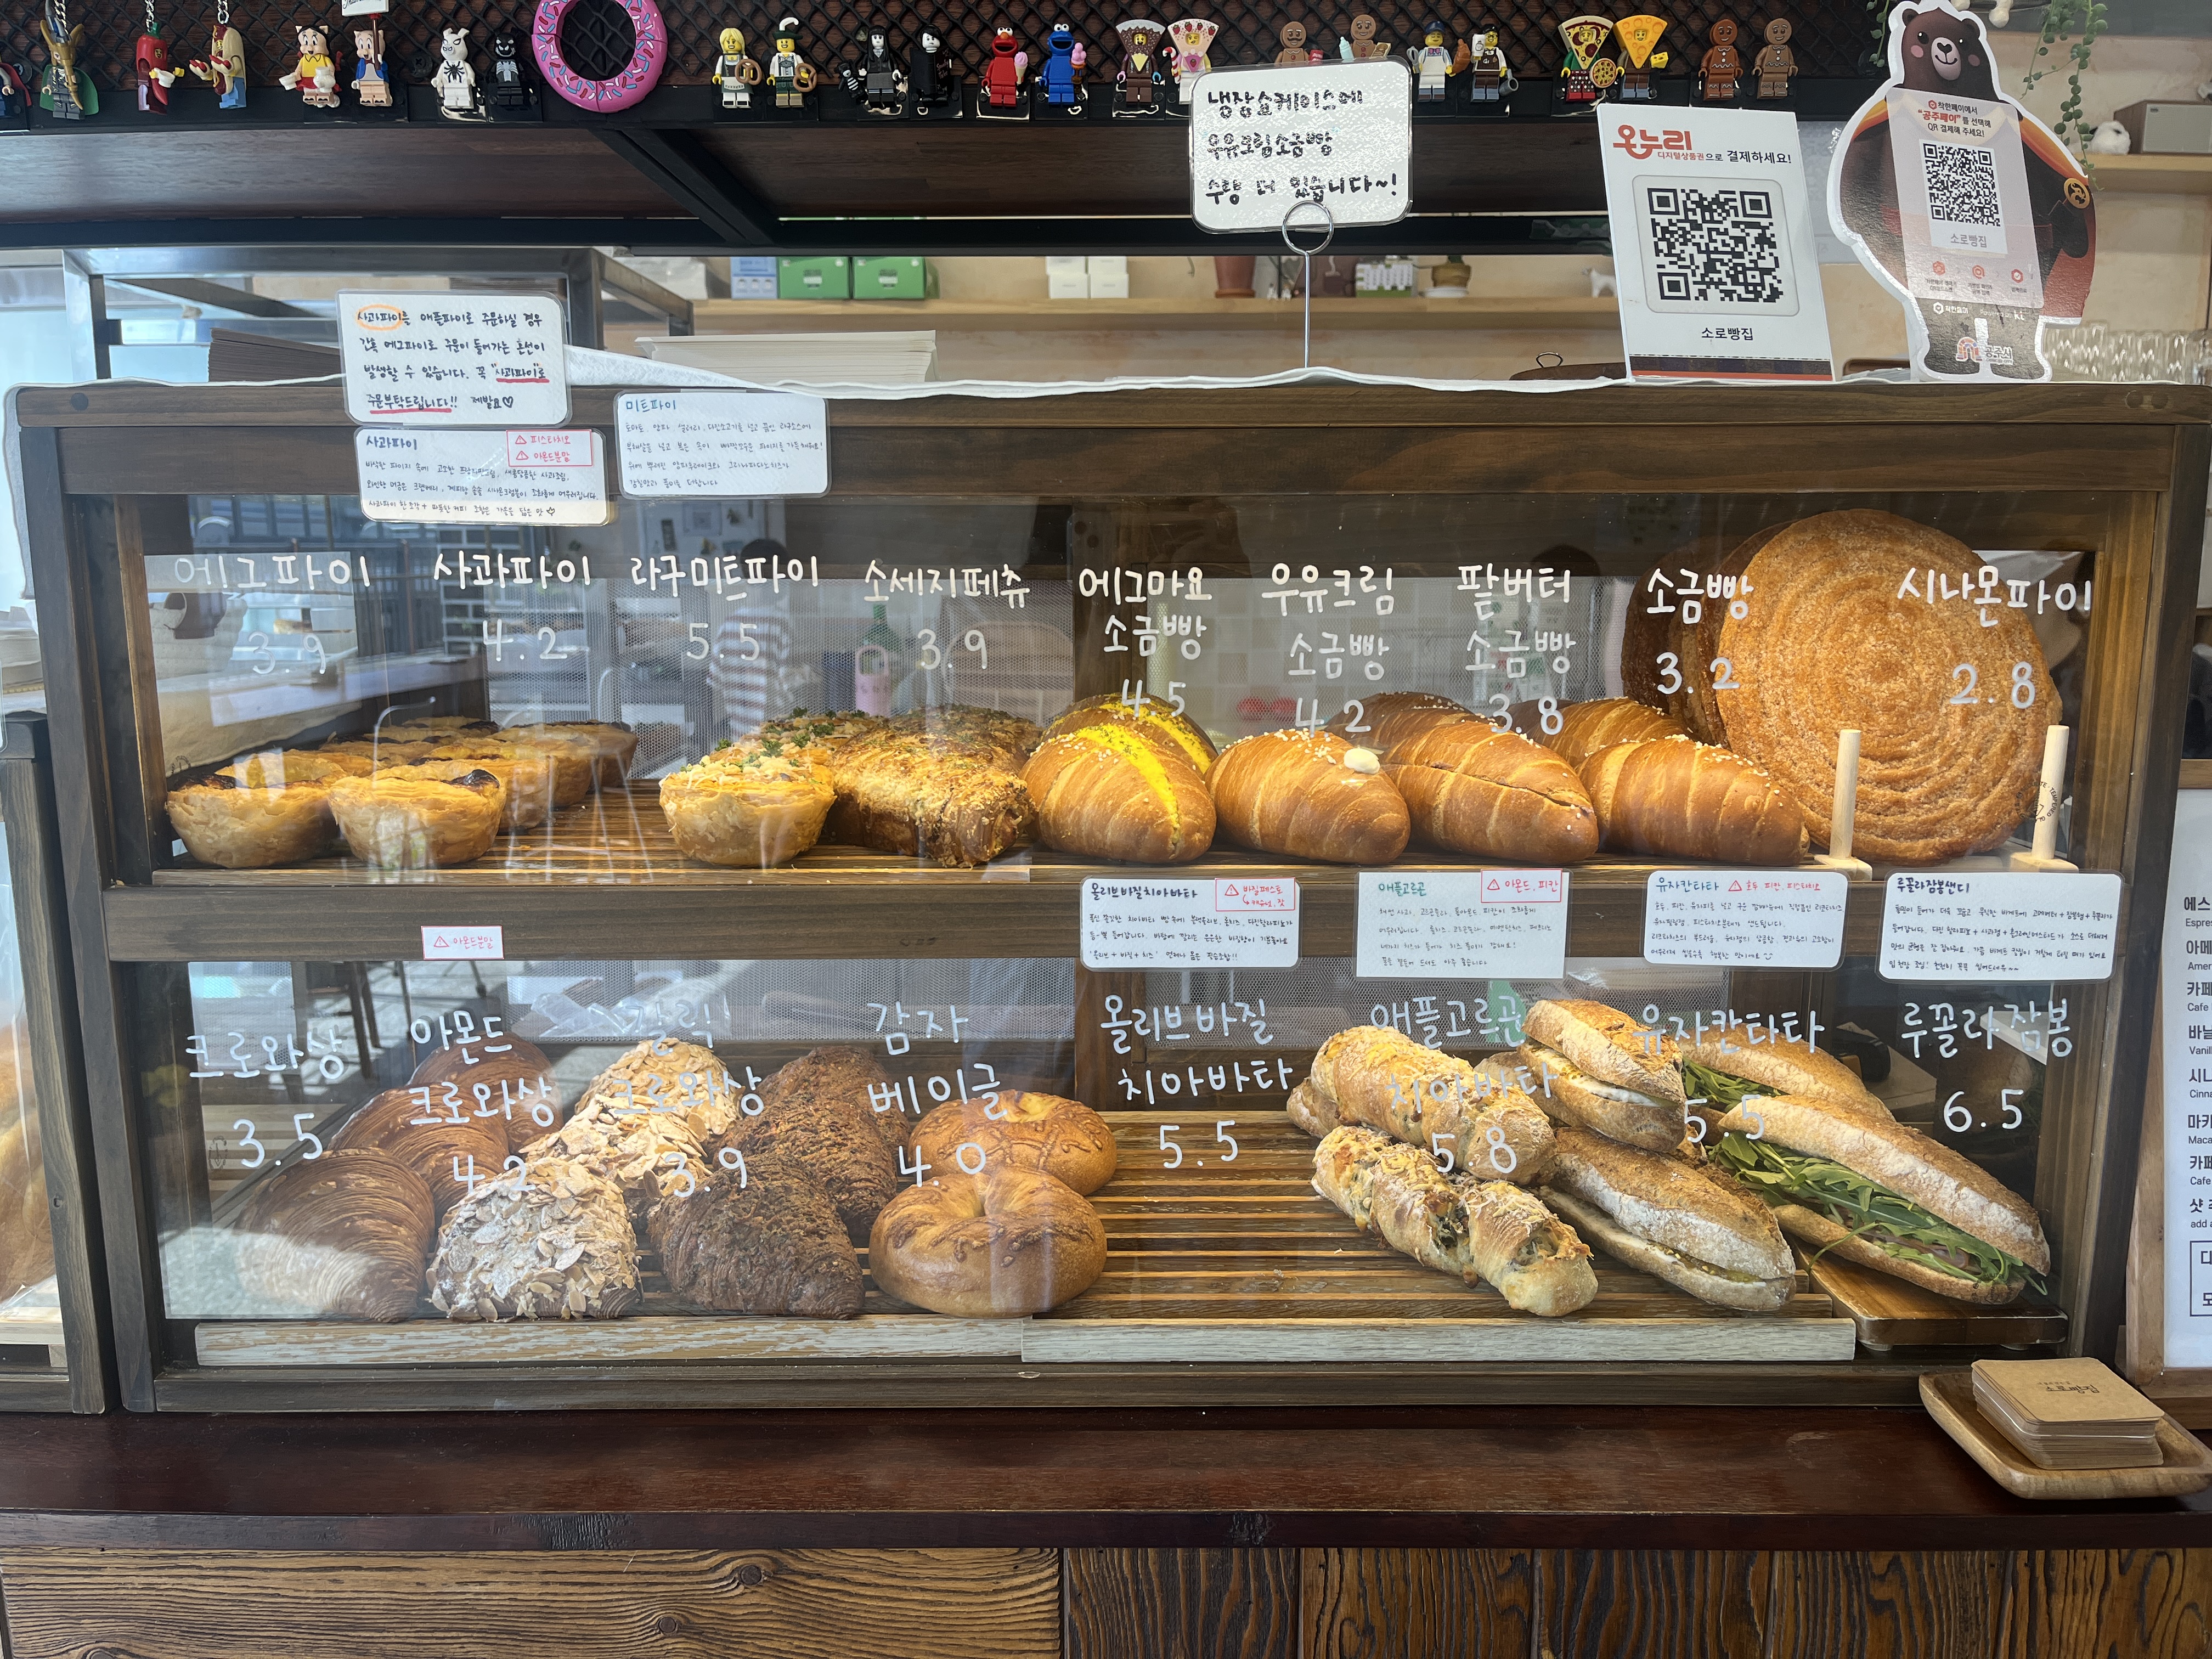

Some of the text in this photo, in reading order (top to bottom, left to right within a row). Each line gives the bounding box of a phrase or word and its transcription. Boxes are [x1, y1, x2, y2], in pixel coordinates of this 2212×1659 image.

[1938, 101, 1978, 115] 착한페이에서
[1971, 118, 1991, 128] 선택해
[1928, 123, 1985, 137] QR 결제해 주세요!
[1726, 150, 1792, 164] 결제하세요!
[1256, 179, 1276, 195] 더
[1950, 233, 1987, 248] 소로빵집
[358, 311, 542, 327] 사과파이를 애플파이로 주문하실 경우
[1701, 327, 1753, 341] 소로빵집
[360, 337, 545, 355] 간혹 에그파이로 주문이 들어가는 혼선이
[1985, 347, 2012, 359] 공주시
[364, 365, 398, 382] 발생할
[405, 365, 415, 379] 수
[422, 366, 469, 380] 있습니다.
[476, 366, 486, 379] 꼭
[626, 399, 676, 412] 미트파이
[366, 435, 417, 450] 사과파이
[531, 436, 571, 444] 피스타치오
[534, 451, 570, 462] 아몬드분말
[174, 553, 370, 590] 에그파이
[434, 550, 590, 590] 사과파이
[630, 555, 819, 602] 라구미트파이
[863, 558, 1030, 610] 소세지페츄
[1079, 566, 1213, 606] 에그마요
[1261, 563, 1394, 616] 우유크림
[1457, 563, 1571, 621] 팥버터
[1646, 568, 1754, 624] 소금빵
[1897, 565, 2091, 628] 시나몬파이
[247, 631, 326, 674] 3.9
[482, 619, 568, 662] 4.2
[685, 622, 760, 661] 5.5
[917, 629, 989, 670] 3.9
[1103, 614, 1207, 659] 소금빵
[1288, 632, 1390, 681] 소금빵
[1465, 630, 1576, 679] 소금빵
[1656, 652, 1740, 695] 3.2
[1950, 661, 2036, 709] 2.8
[1488, 693, 1564, 735] 3.8
[1243, 885, 1283, 896] 바질페스토
[1379, 882, 1426, 896] 애플고르곤
[1538, 880, 1559, 892] 피칸
[1656, 877, 1719, 893] 유자칸타타
[453, 935, 494, 950] 아몬드분말
[627, 1000, 714, 1057] 갈릭
[866, 1000, 969, 1056] 감자
[1370, 995, 1526, 1050] 애플고르곤
[2188, 1003, 2209, 1011] Cafe
[410, 1010, 512, 1065] 아몬드
[1632, 1003, 1826, 1055] 유자칸타타
[185, 1031, 344, 1080] 크로와상
[408, 1076, 555, 1127] 크로와상
[612, 1066, 765, 1116] 크로와상
[867, 1062, 1008, 1120] 베이글
[1118, 1057, 1294, 1105] 치아바타
[1386, 1061, 1559, 1115] 치아바타
[1683, 1093, 1765, 1145] 5.5
[1943, 1088, 2024, 1133] 6.5
[233, 1112, 323, 1169] 3.5
[1159, 1119, 1239, 1169] 5.5
[1431, 1125, 1517, 1175] 5.8
[663, 1147, 748, 1198] 3.9
[898, 1141, 987, 1188] 4.0
[2190, 1176, 2211, 1185] Cafe
[2190, 1198, 2203, 1213] 샷
[2191, 1220, 2207, 1228] add
